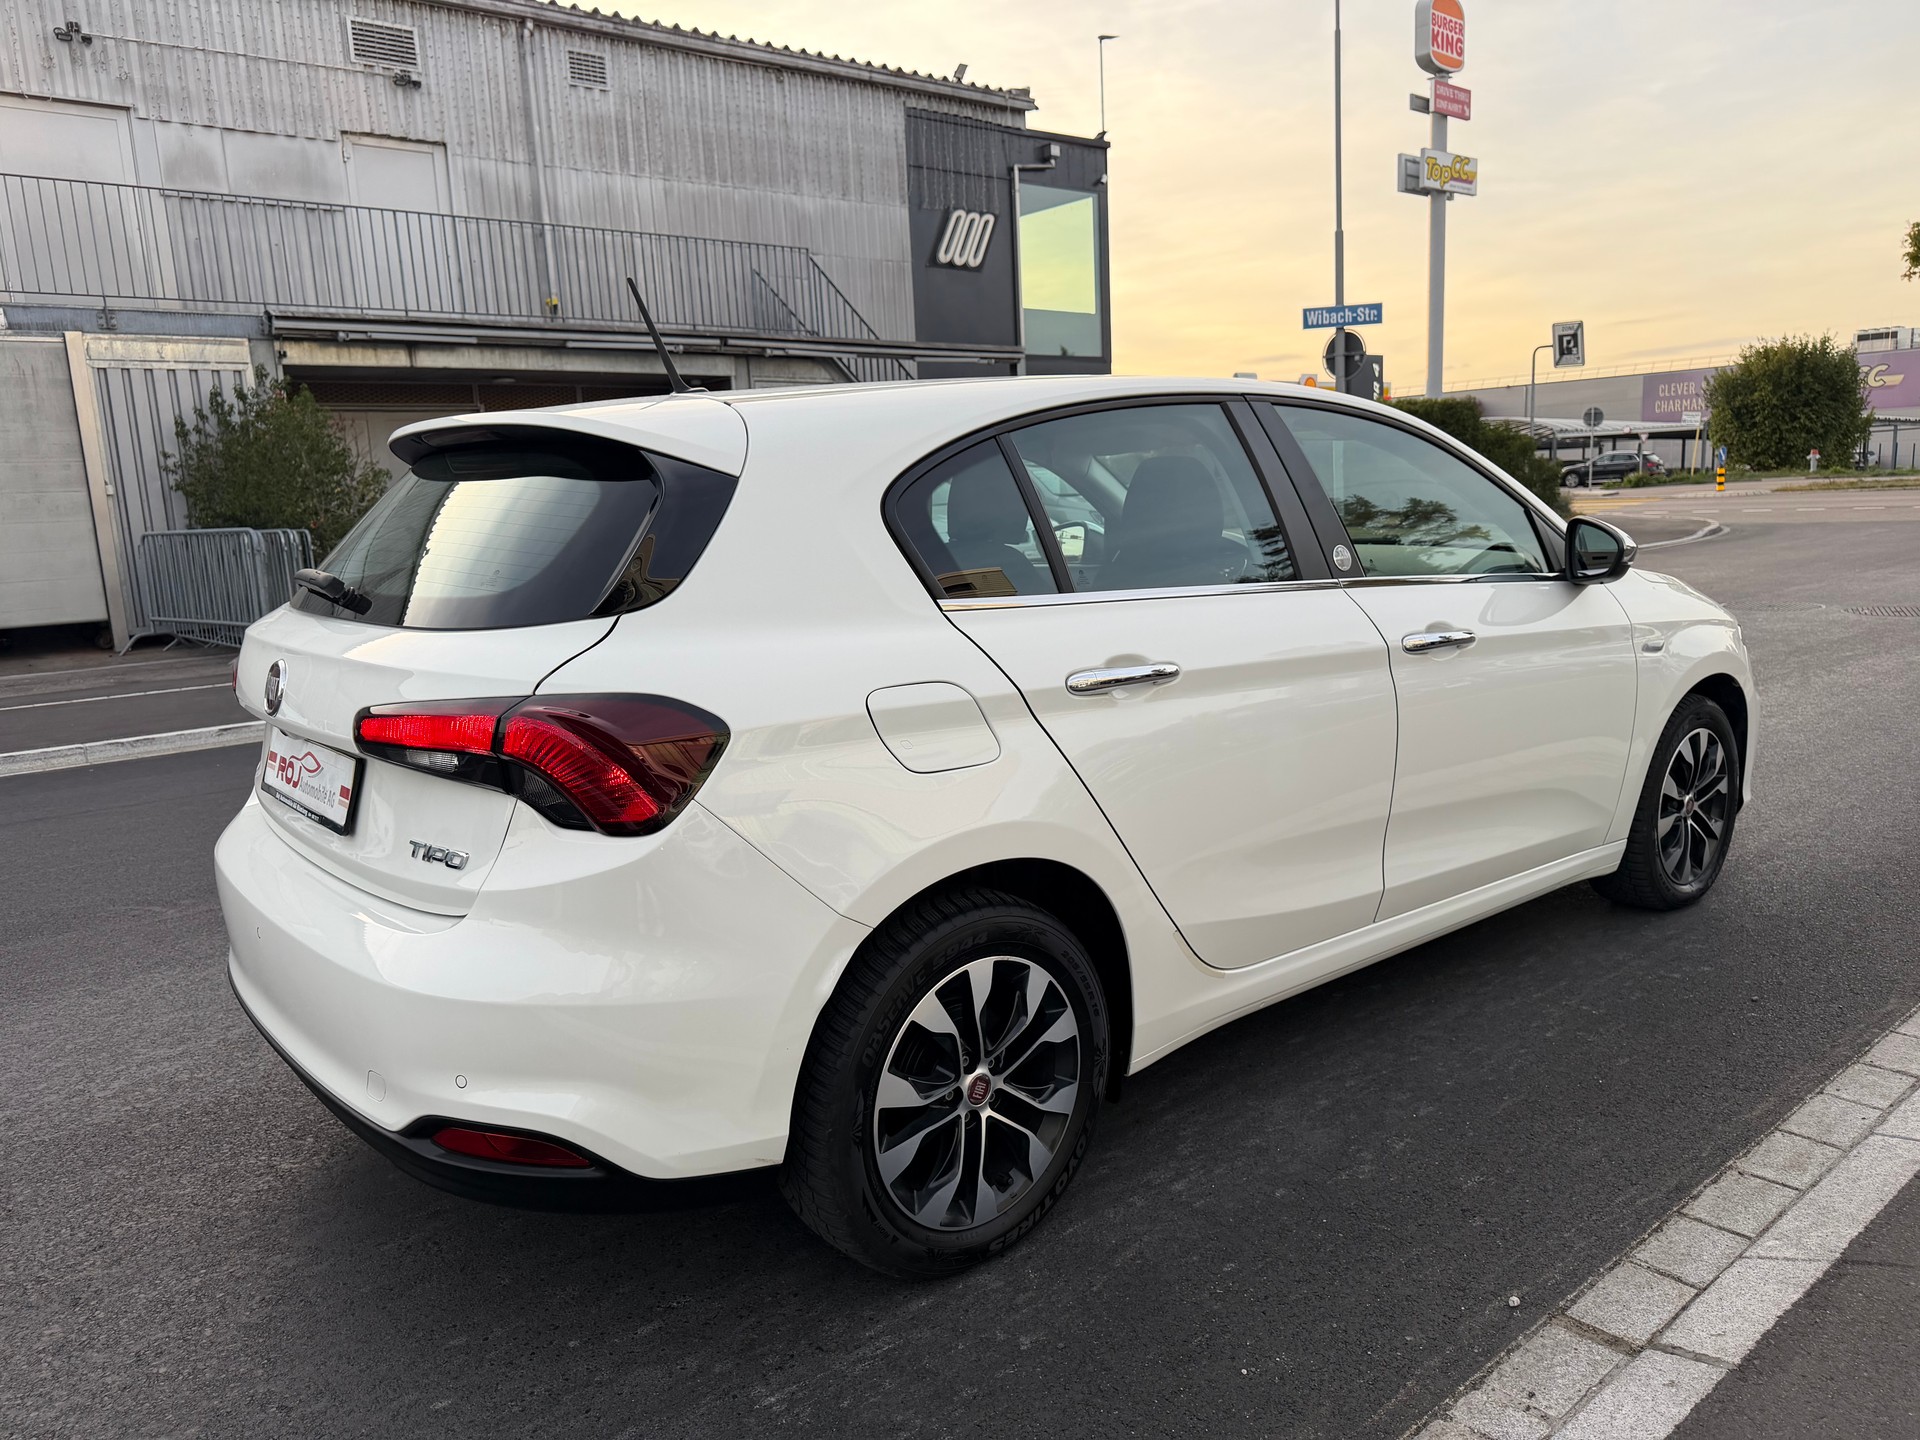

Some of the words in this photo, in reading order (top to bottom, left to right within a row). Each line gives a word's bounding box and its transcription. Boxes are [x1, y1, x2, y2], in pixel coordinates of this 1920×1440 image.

[1431, 12, 1464, 37] BURGER
[1431, 28, 1463, 58] KING
[1436, 84, 1454, 99] DRIVE
[1306, 307, 1378, 326] Wibach-Str.
[1658, 381, 1696, 397] CLEVER
[1655, 397, 1706, 414] CHARMAN
[298, 778, 328, 805] Automobile
[326, 790, 336, 808] AG
[409, 839, 471, 870] TIPO
[972, 1079, 988, 1101] FIAT
[988, 1193, 1056, 1253] TIRES
